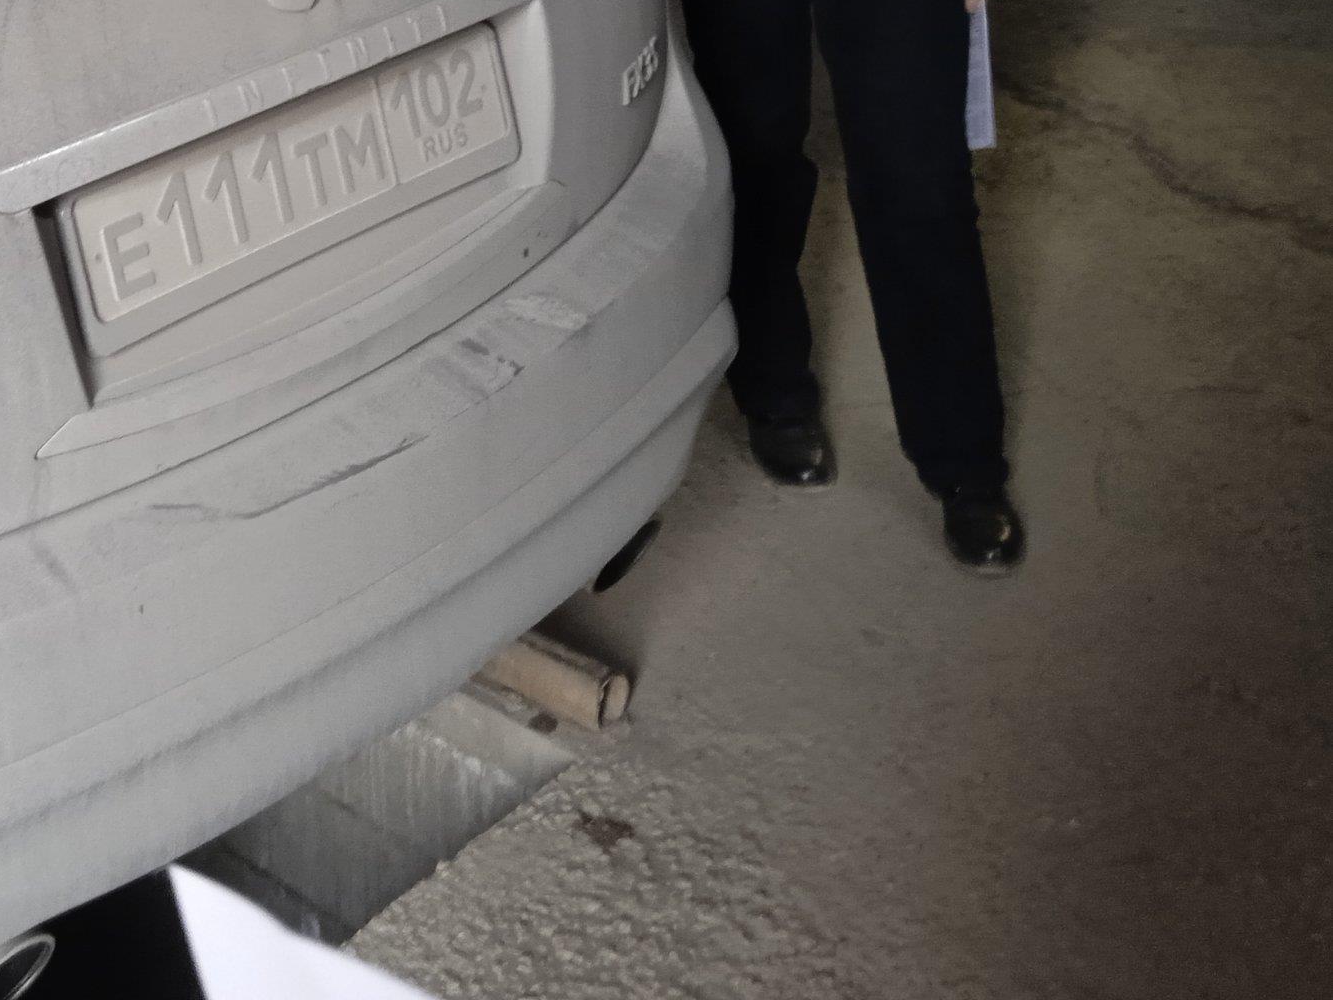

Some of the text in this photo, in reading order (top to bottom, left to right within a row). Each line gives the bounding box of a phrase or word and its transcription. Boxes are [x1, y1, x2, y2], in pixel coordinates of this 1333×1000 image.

[201, 3, 449, 131] INFINITI
[100, 46, 485, 303] Е111ТМ 102
[422, 121, 468, 162] RUS
